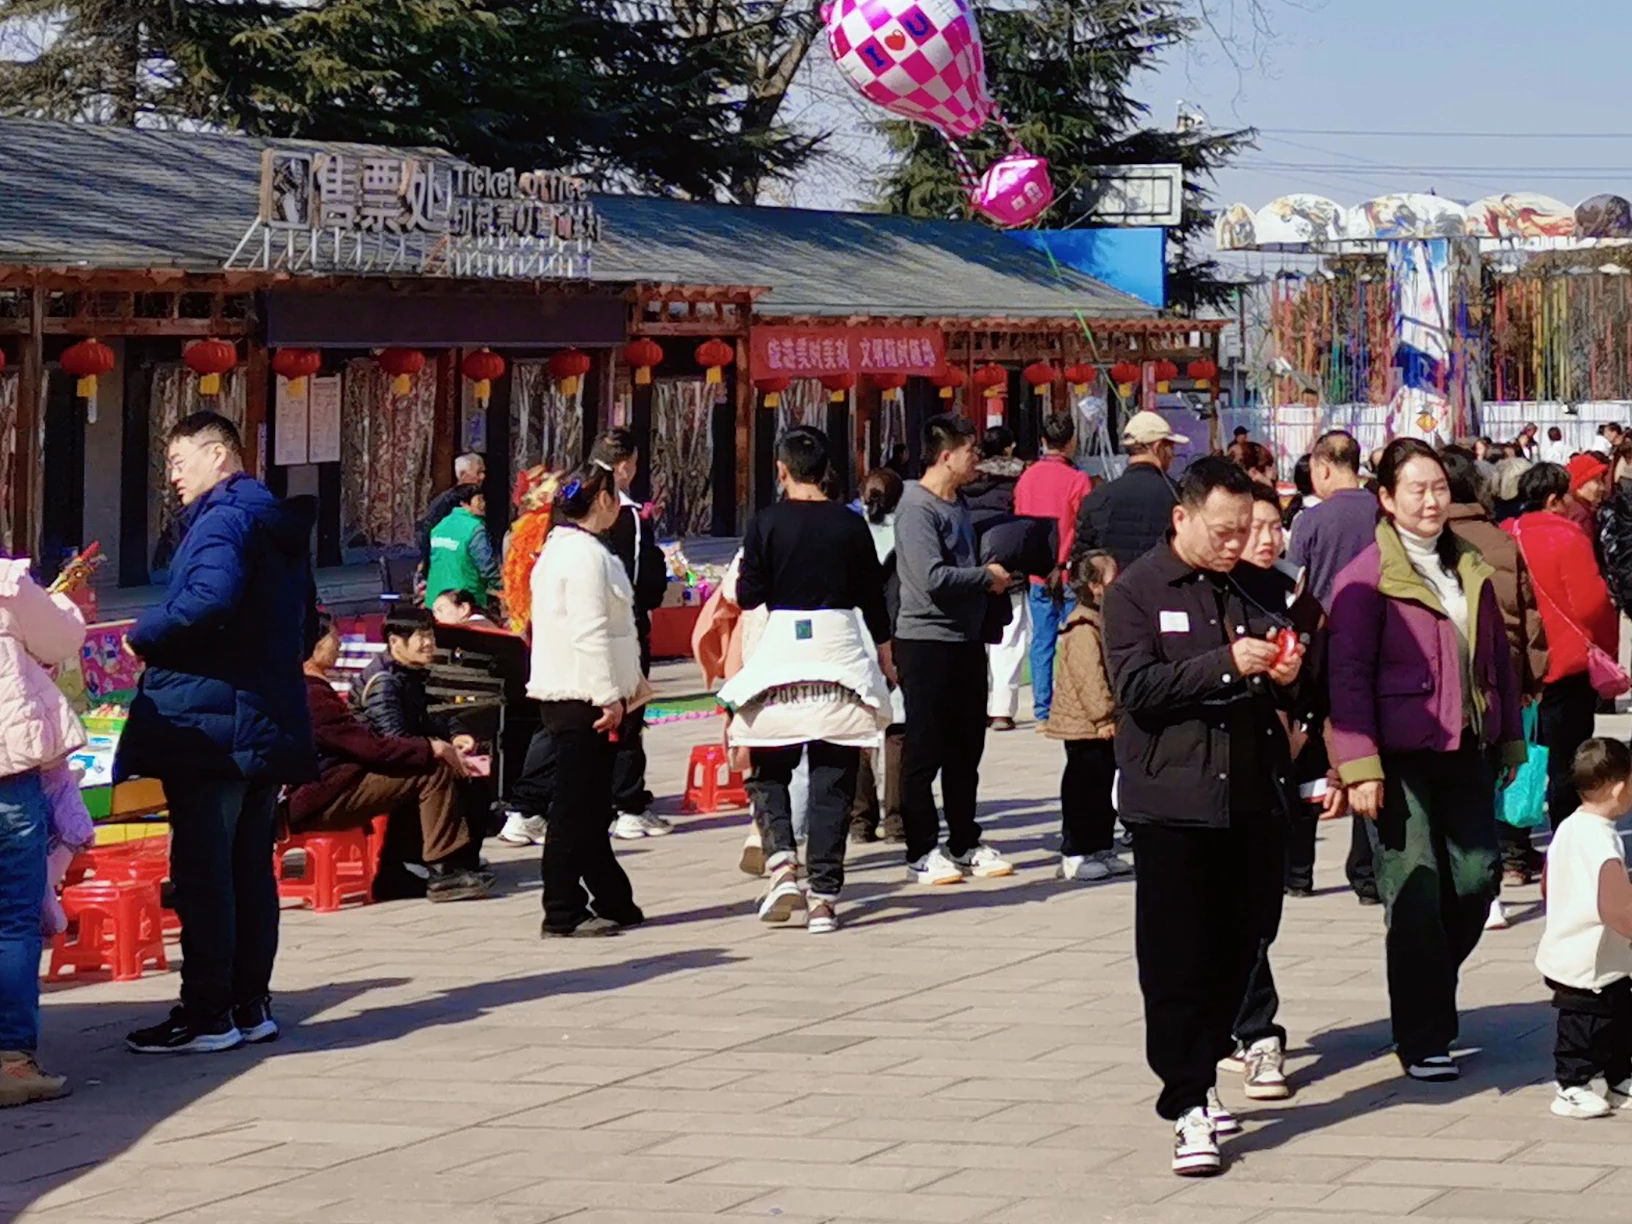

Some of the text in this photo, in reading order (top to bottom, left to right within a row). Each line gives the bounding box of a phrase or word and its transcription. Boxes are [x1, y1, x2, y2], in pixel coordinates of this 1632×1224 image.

[312, 154, 451, 233] 售票处
[453, 166, 517, 198] Ticket
